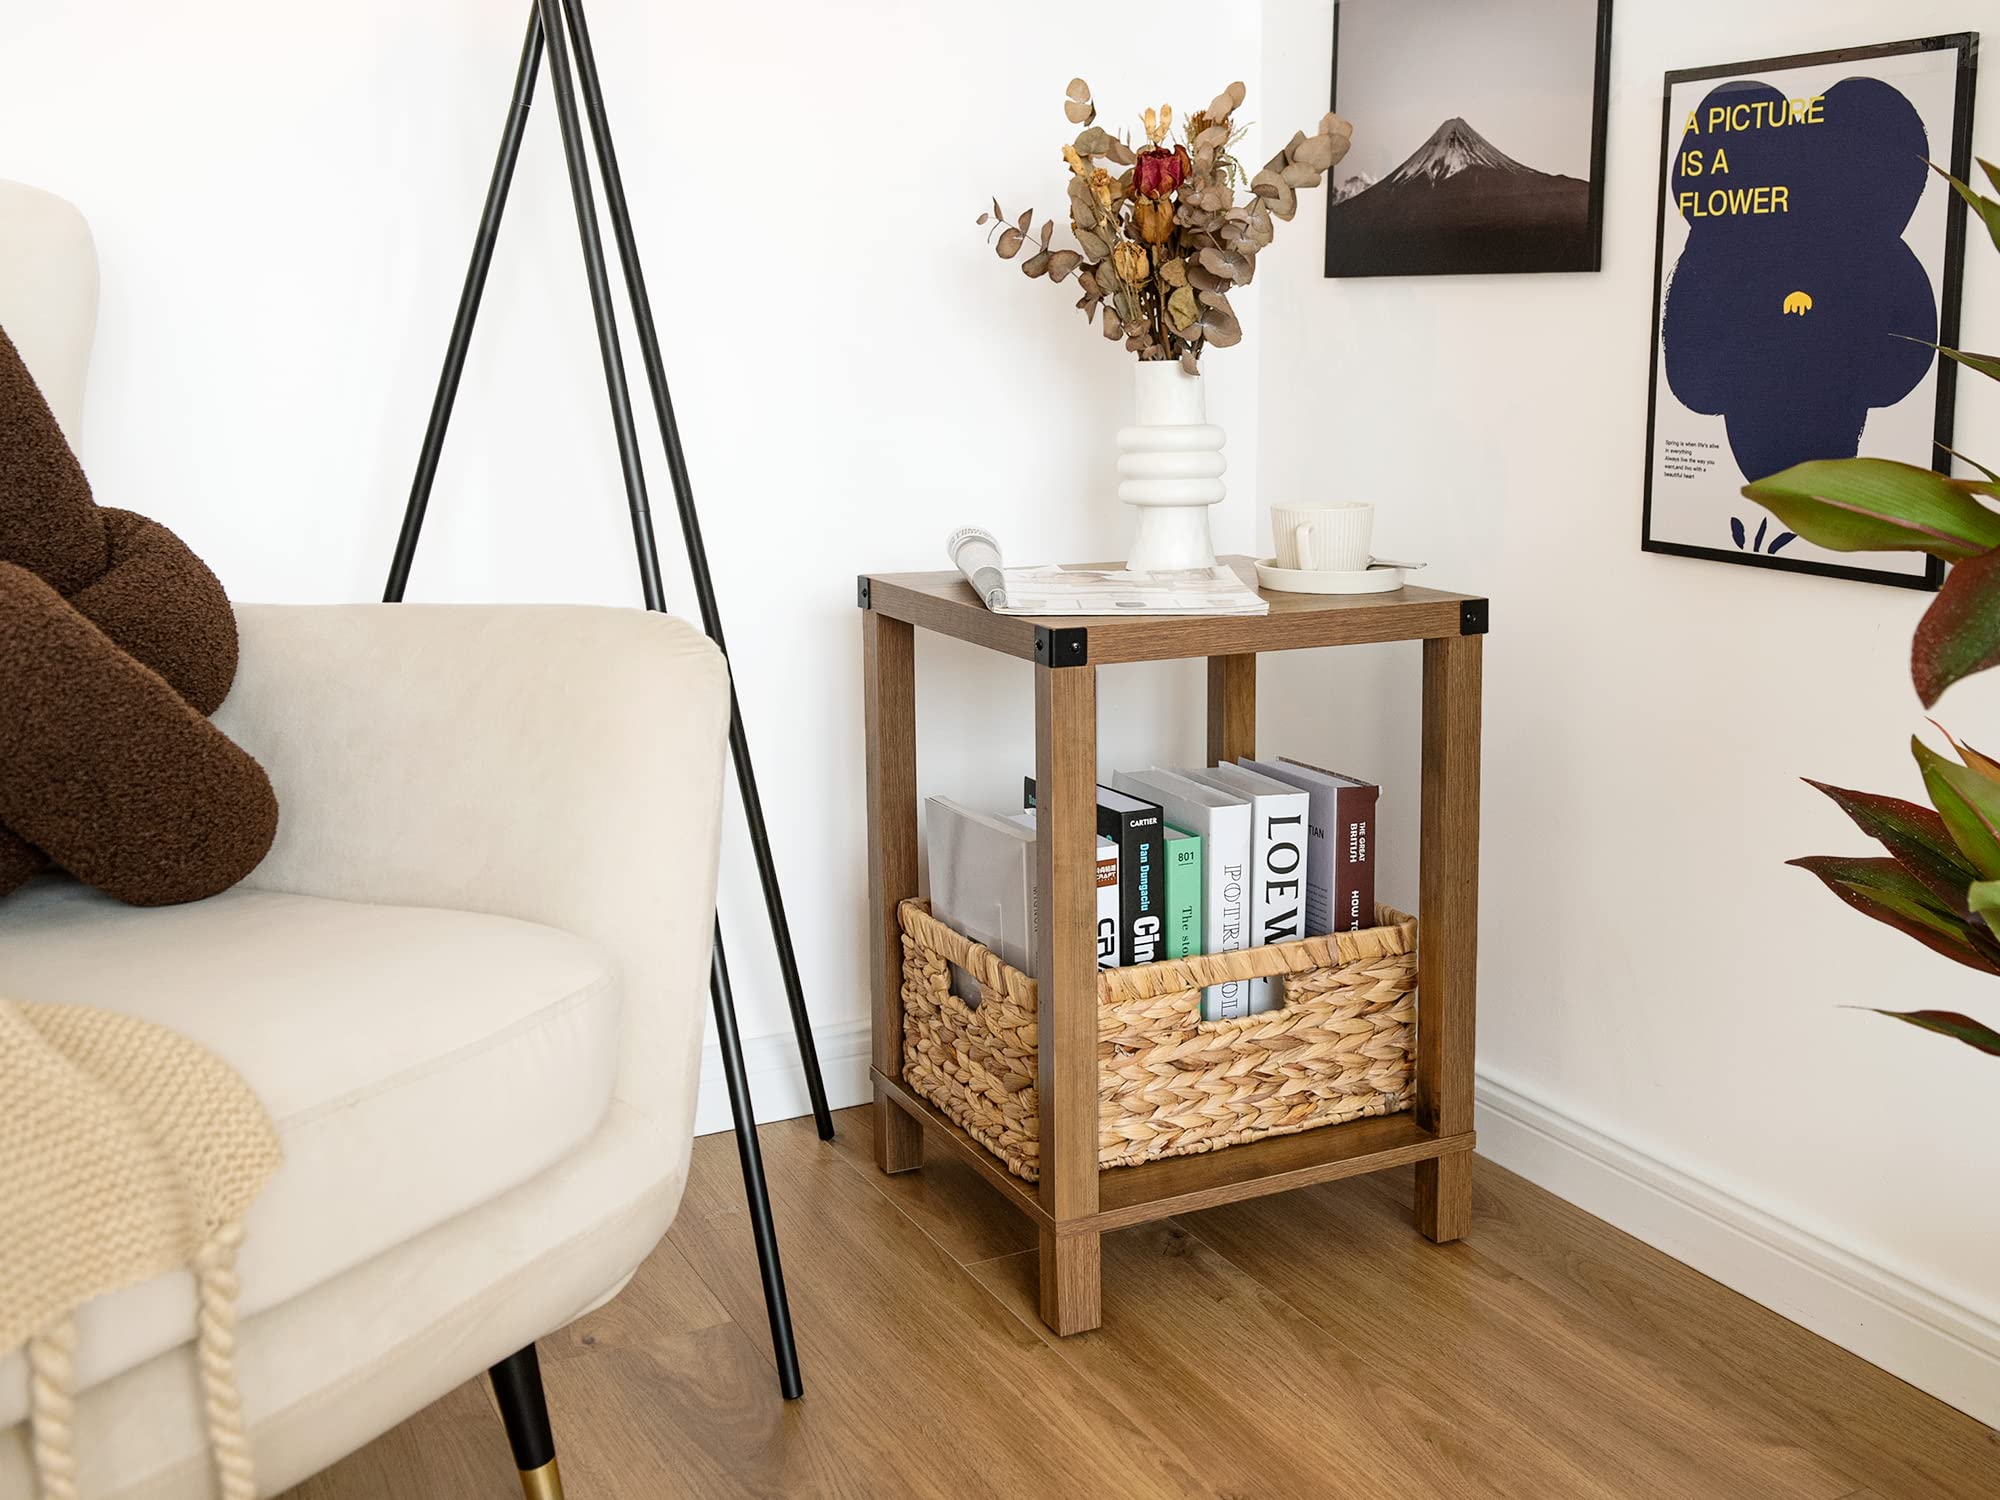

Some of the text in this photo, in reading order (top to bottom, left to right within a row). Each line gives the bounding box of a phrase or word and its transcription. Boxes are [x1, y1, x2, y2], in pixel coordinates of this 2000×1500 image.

[1682, 95, 1825, 135] A PICTURE
[1681, 148, 1729, 177] IS A
[1679, 186, 1789, 217] FLOWER
[1130, 817, 1158, 828] CARTIER
[1177, 851, 1194, 862] 801
[1349, 822, 1358, 863] BRITISH
[1138, 843, 1151, 912] Dan Dungaciu
[1265, 814, 1301, 985] LOEW
[1351, 890, 1360, 918] HOW
[1181, 905, 1193, 931] The
[1133, 915, 1161, 967] Cin
